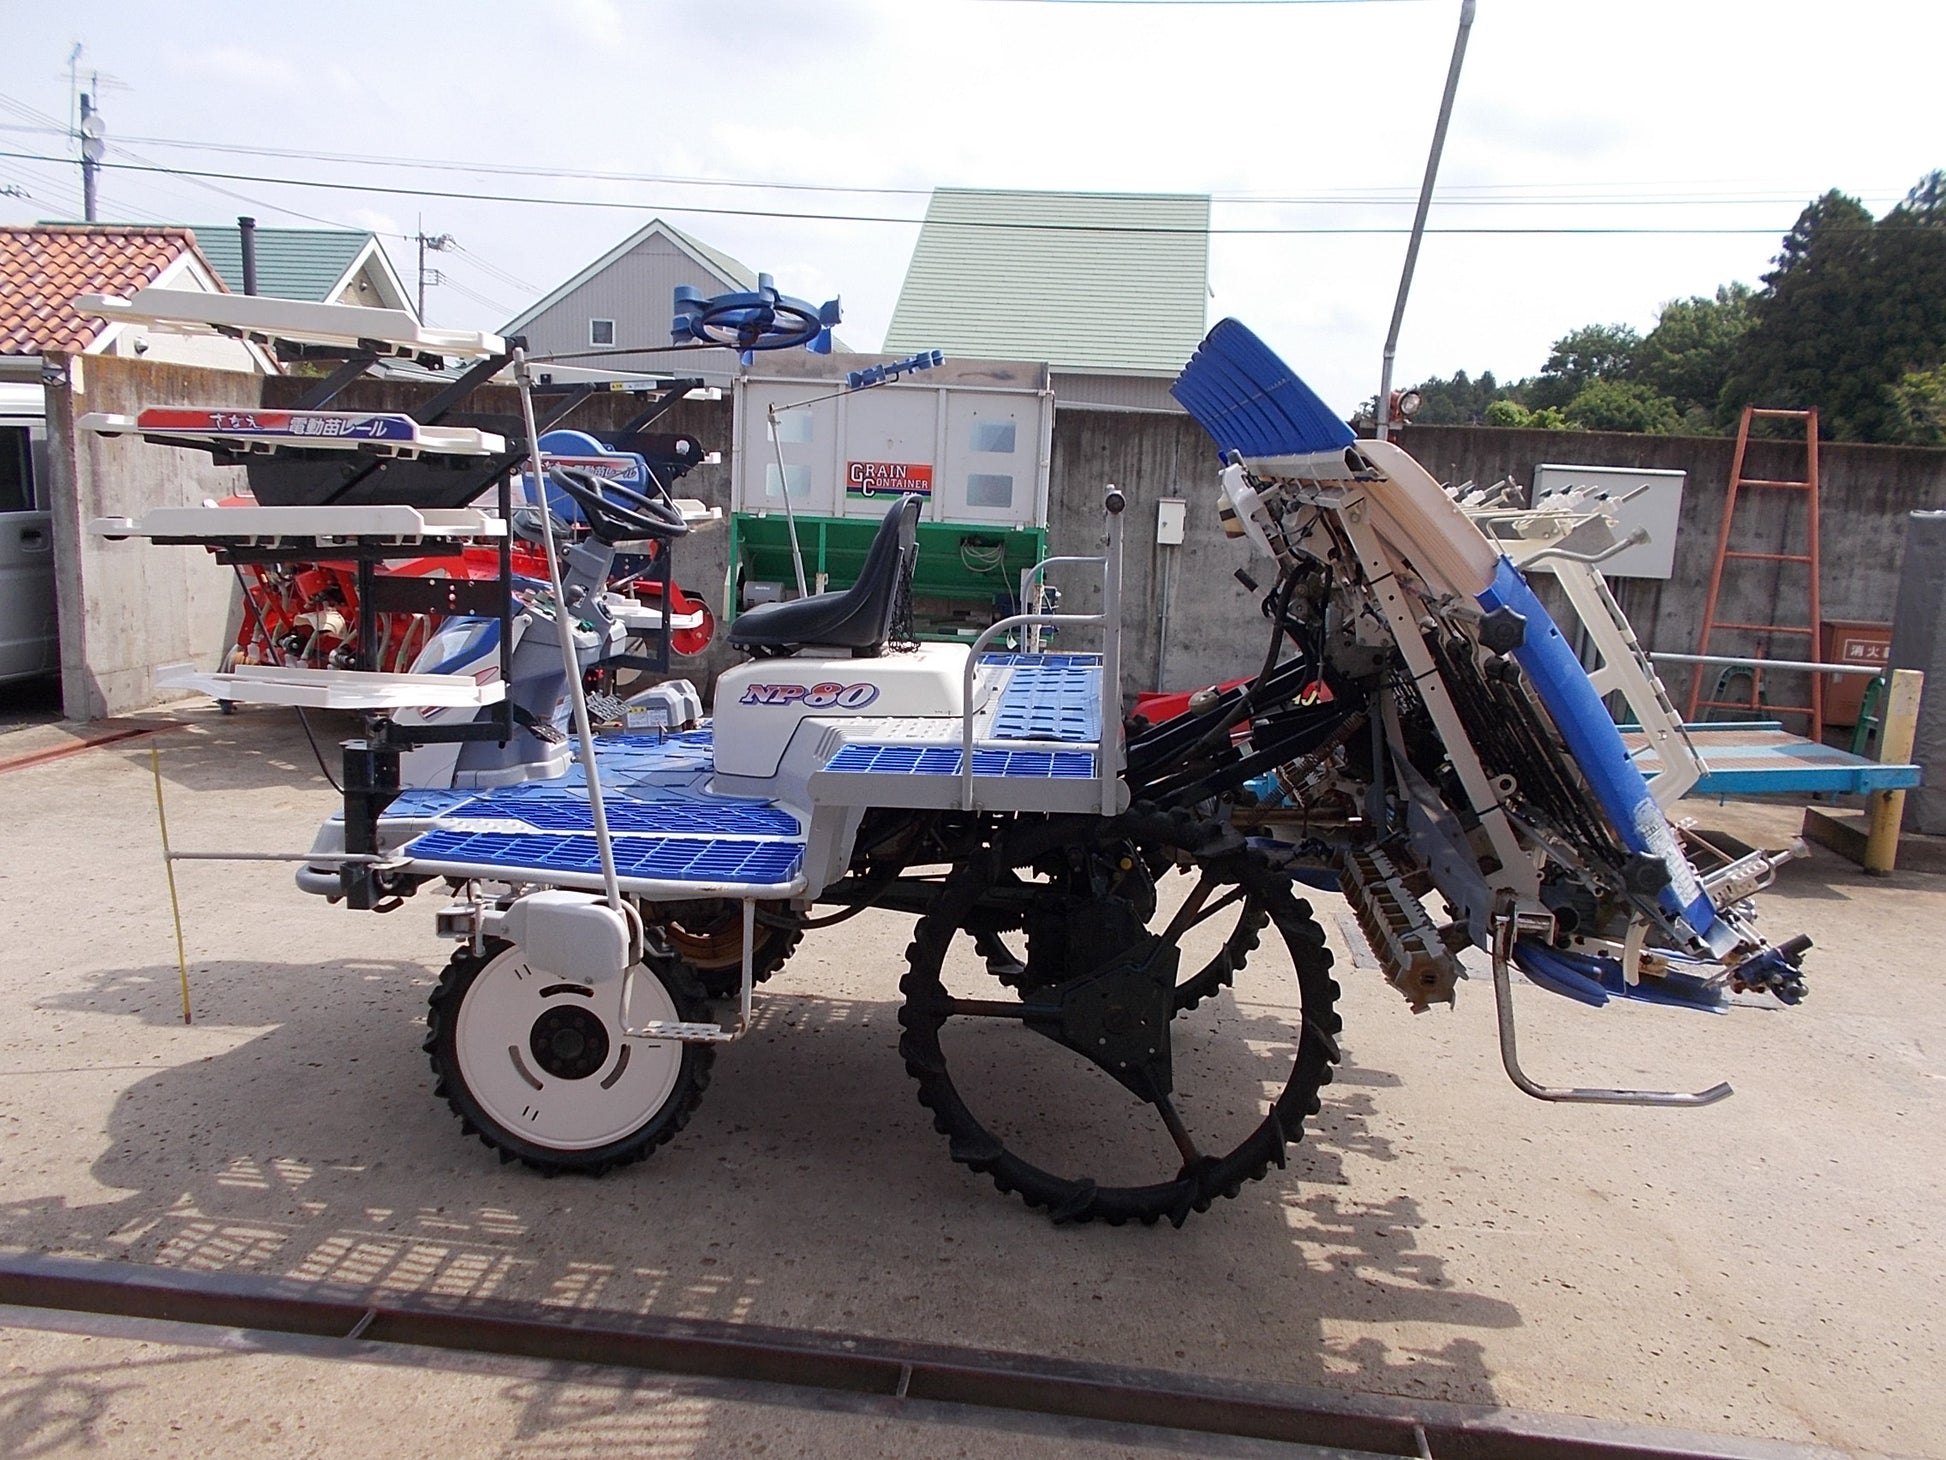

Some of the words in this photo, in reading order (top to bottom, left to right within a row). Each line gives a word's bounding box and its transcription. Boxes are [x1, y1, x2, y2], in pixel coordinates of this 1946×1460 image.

[209, 413, 263, 430] さなえ
[289, 416, 387, 437] 電動苗レール
[850, 463, 907, 482] GRAIN
[862, 478, 928, 497] CONTAINER
[739, 682, 880, 709] NP80
